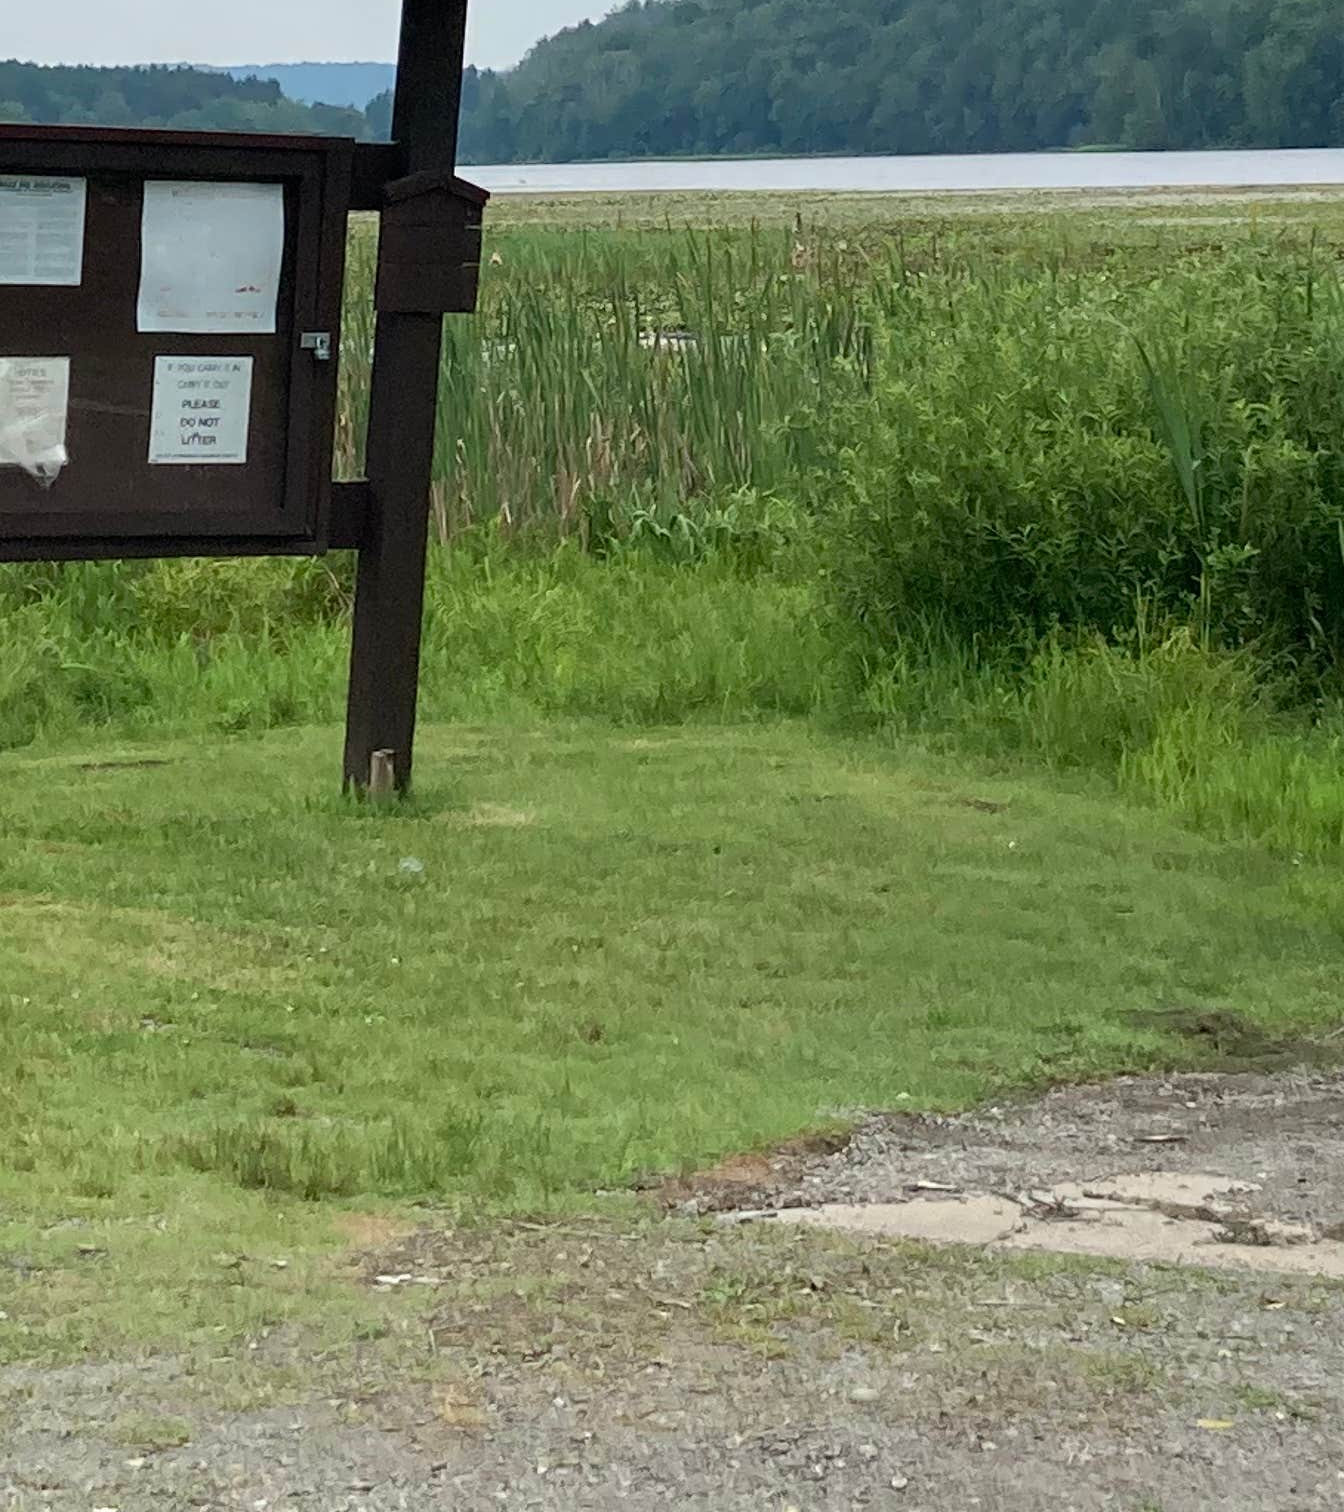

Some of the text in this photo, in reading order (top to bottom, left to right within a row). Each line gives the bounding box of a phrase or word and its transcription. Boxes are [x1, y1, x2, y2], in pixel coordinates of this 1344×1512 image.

[181, 399, 221, 409] PLEASE
[180, 417, 221, 428] DO NOT
[180, 432, 217, 445] LITTER
